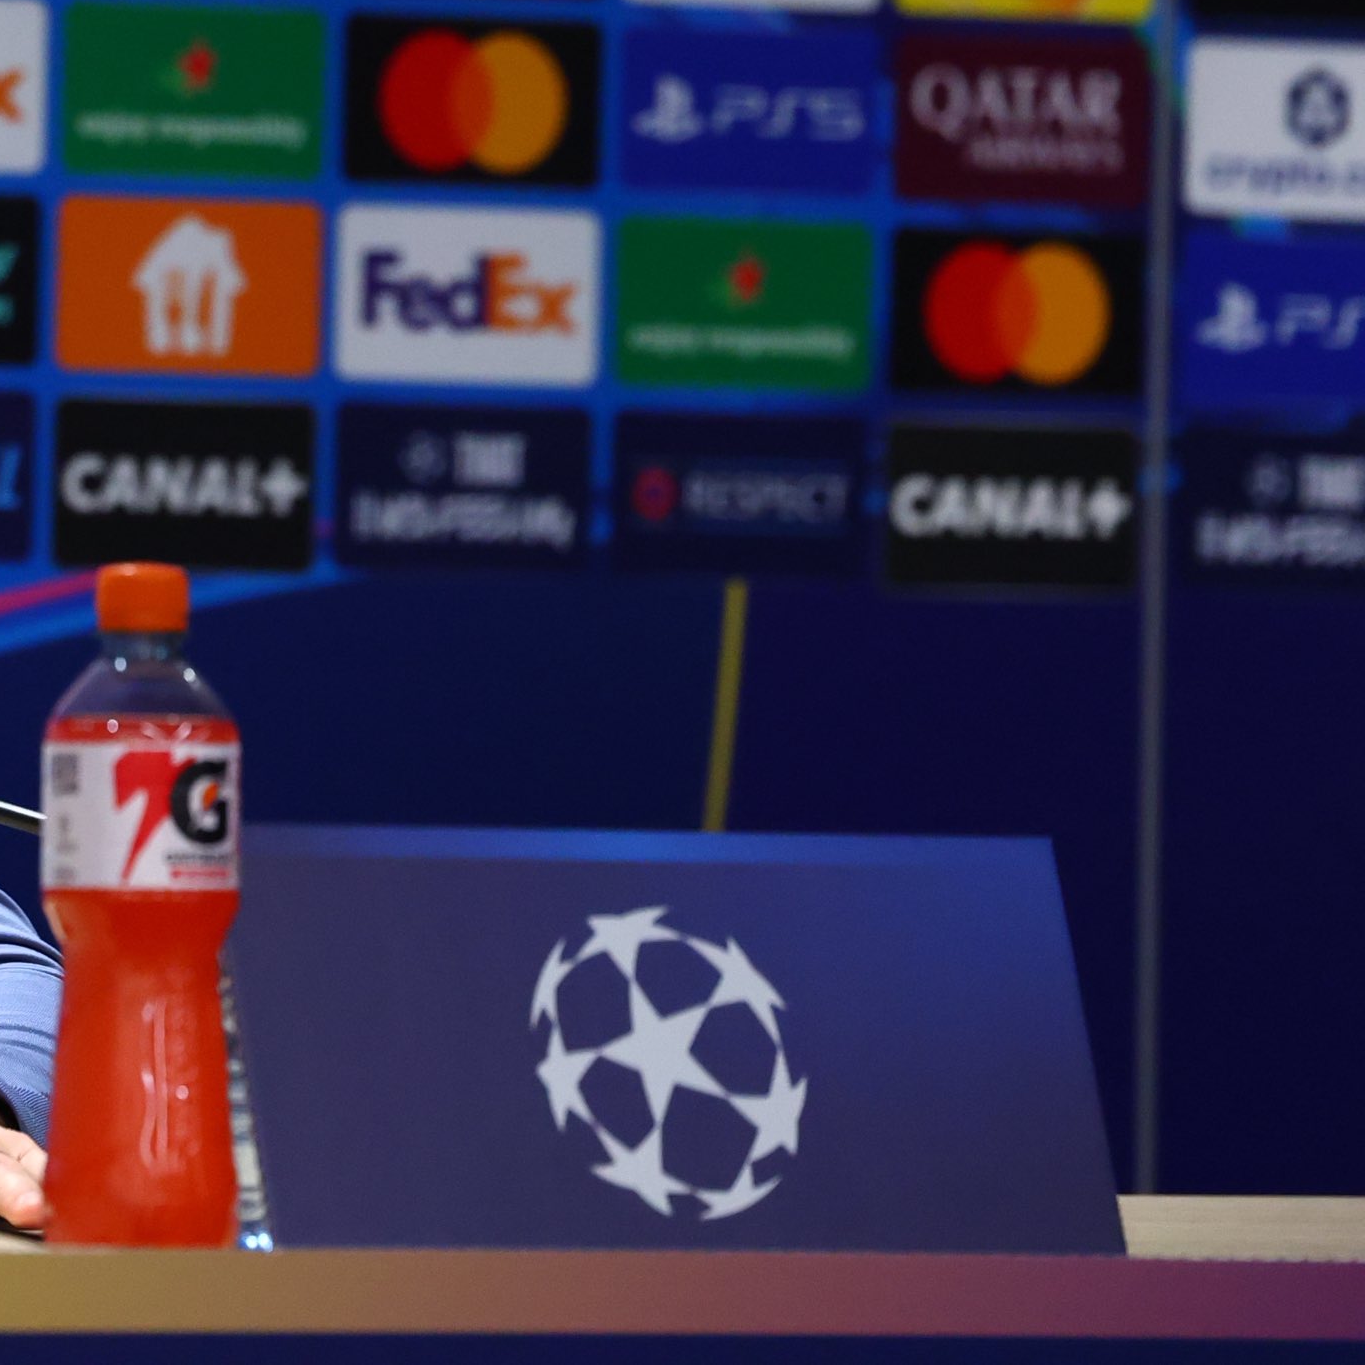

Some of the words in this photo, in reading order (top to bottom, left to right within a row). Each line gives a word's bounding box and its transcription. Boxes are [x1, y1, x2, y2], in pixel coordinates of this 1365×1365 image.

[909, 63, 1123, 142] QATAR
[361, 249, 576, 337] FedEx
[1274, 293, 1365, 350] PS
[61, 453, 308, 518] CANAL+
[890, 472, 1131, 538] CANAL+
[171, 760, 229, 844] G
